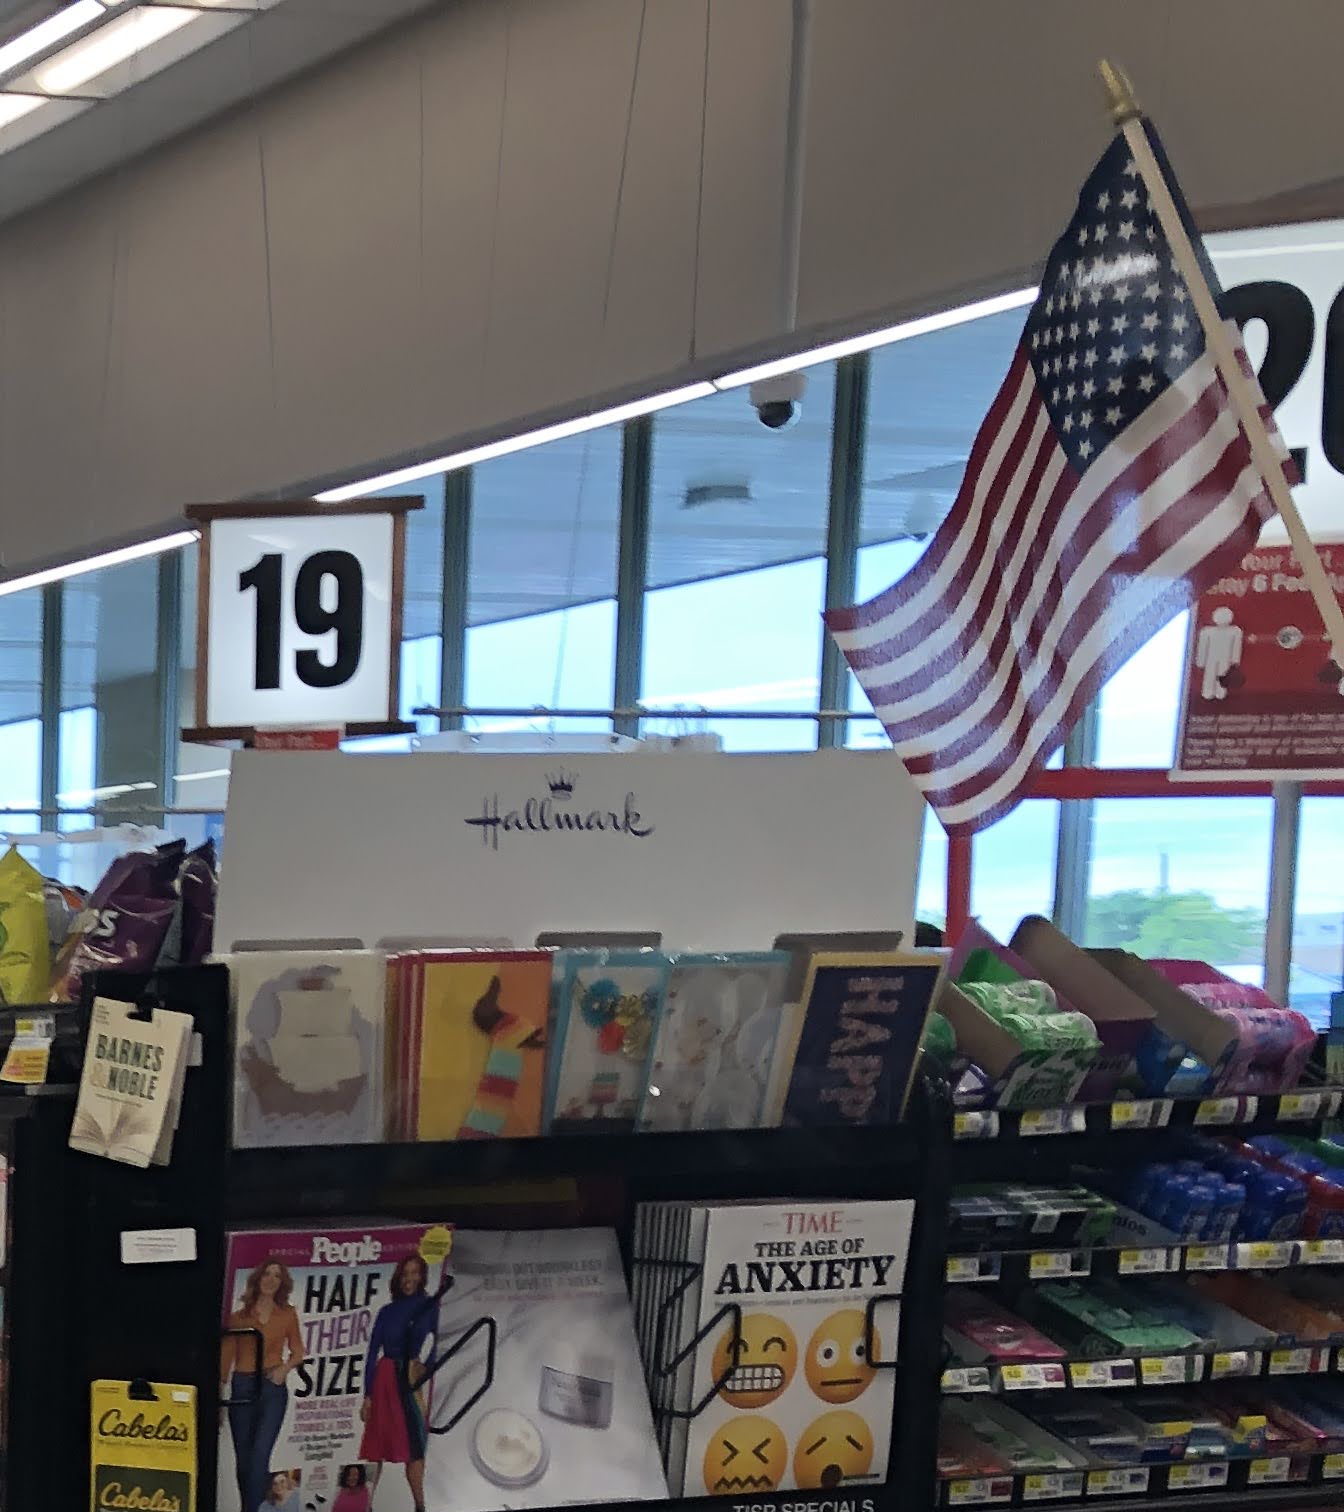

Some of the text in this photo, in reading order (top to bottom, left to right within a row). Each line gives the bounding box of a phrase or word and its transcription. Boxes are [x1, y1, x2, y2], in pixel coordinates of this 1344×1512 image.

[239, 550, 363, 691] 19
[465, 794, 654, 851] Hallmark
[95, 1033, 164, 1072] BARNES
[819, 974, 903, 1124] HAPP
[108, 1065, 158, 1101] NOBLE
[782, 1211, 845, 1235] TIME
[311, 1235, 382, 1267] People
[755, 1238, 864, 1258] THE AGE OF
[304, 1272, 381, 1314] HALF
[714, 1255, 895, 1295] ANXIETY
[303, 1310, 371, 1355] THEIR
[294, 1354, 364, 1398] SIZE
[98, 1408, 189, 1442] Cabela's
